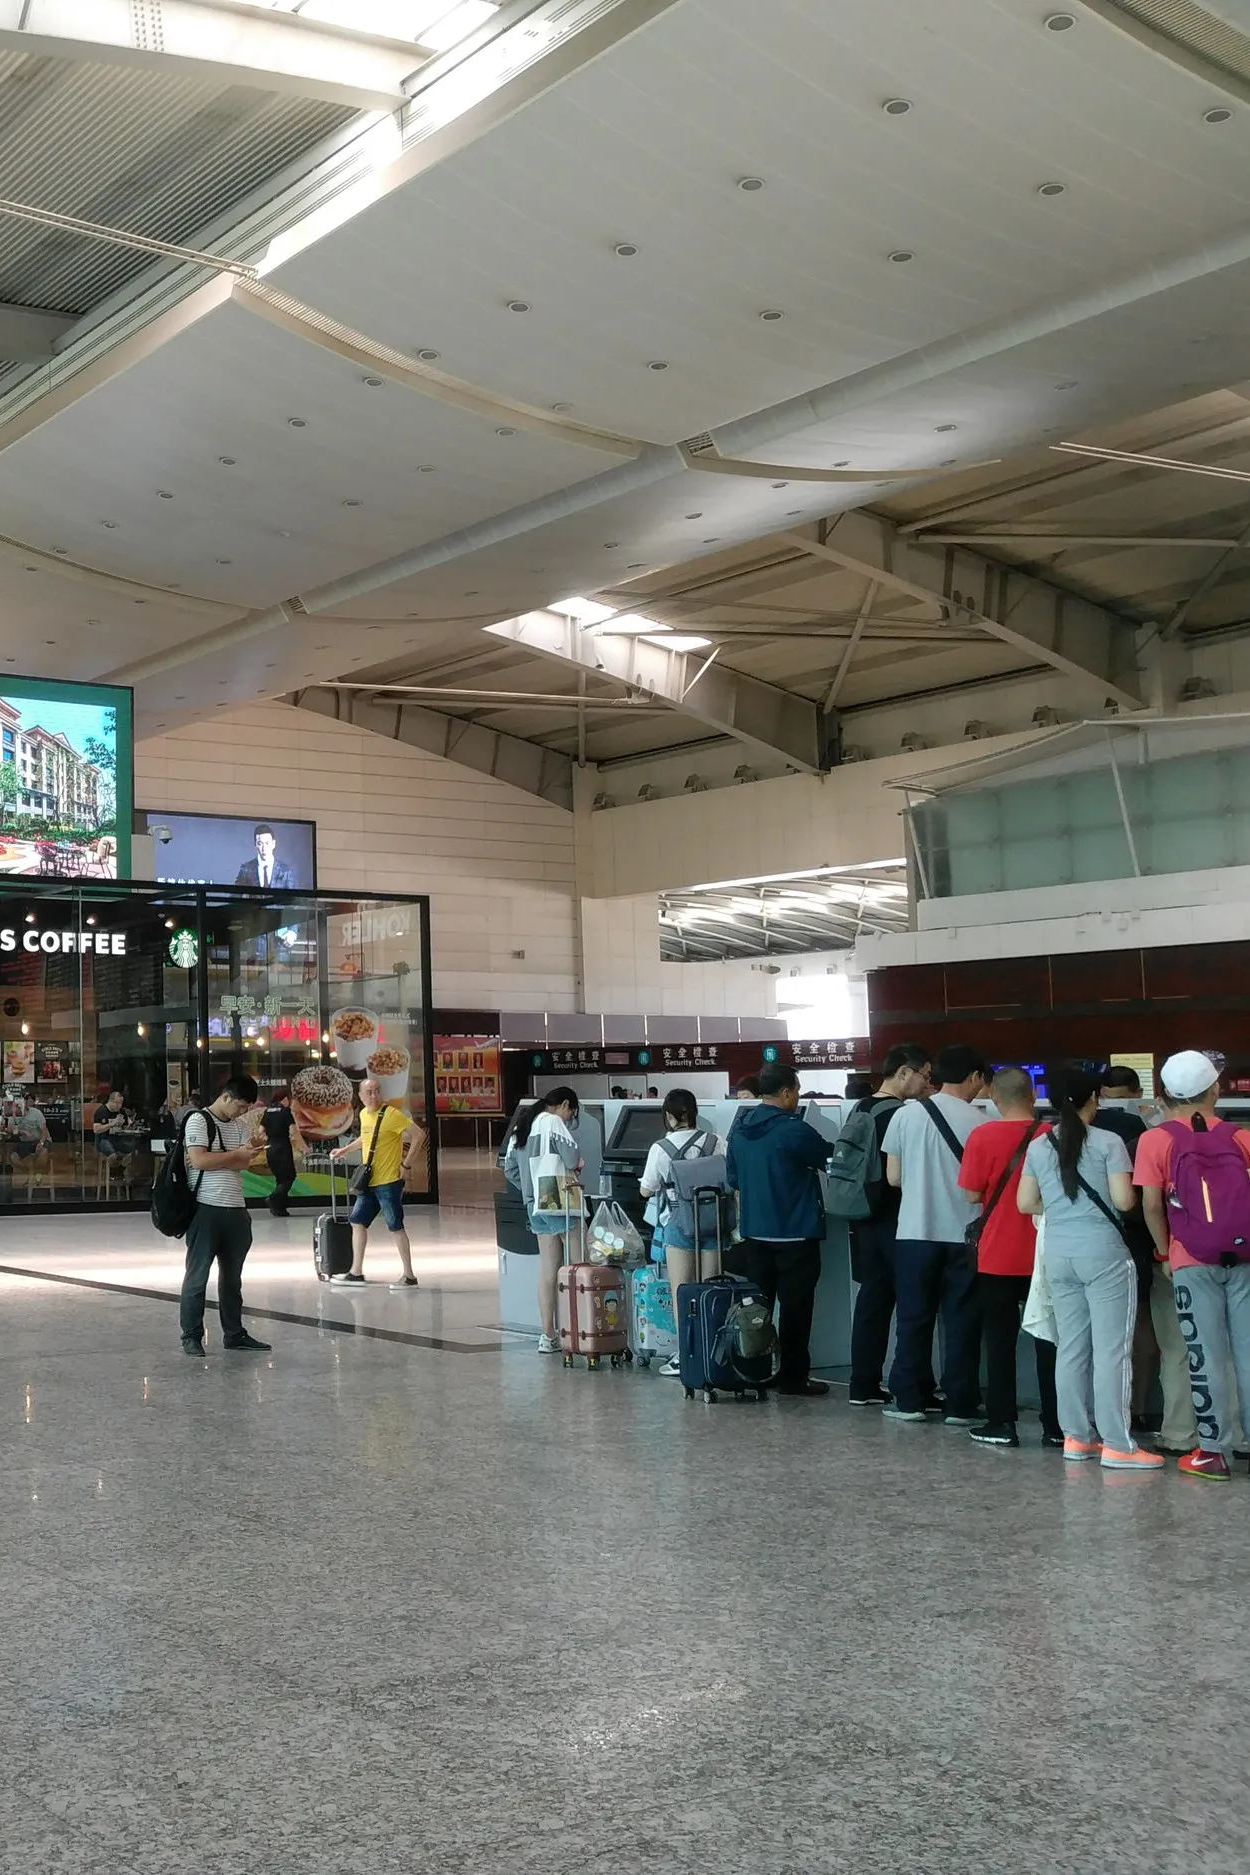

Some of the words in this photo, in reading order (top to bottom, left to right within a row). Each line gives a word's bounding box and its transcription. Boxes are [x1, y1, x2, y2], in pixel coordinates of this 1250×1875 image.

[22, 930, 127, 956] COFFEE
[665, 1059, 692, 1067] Security
[694, 1058, 717, 1066] Check
[794, 1055, 827, 1064] Security
[828, 1054, 853, 1062] Check
[1174, 1284, 1220, 1441] adidas
